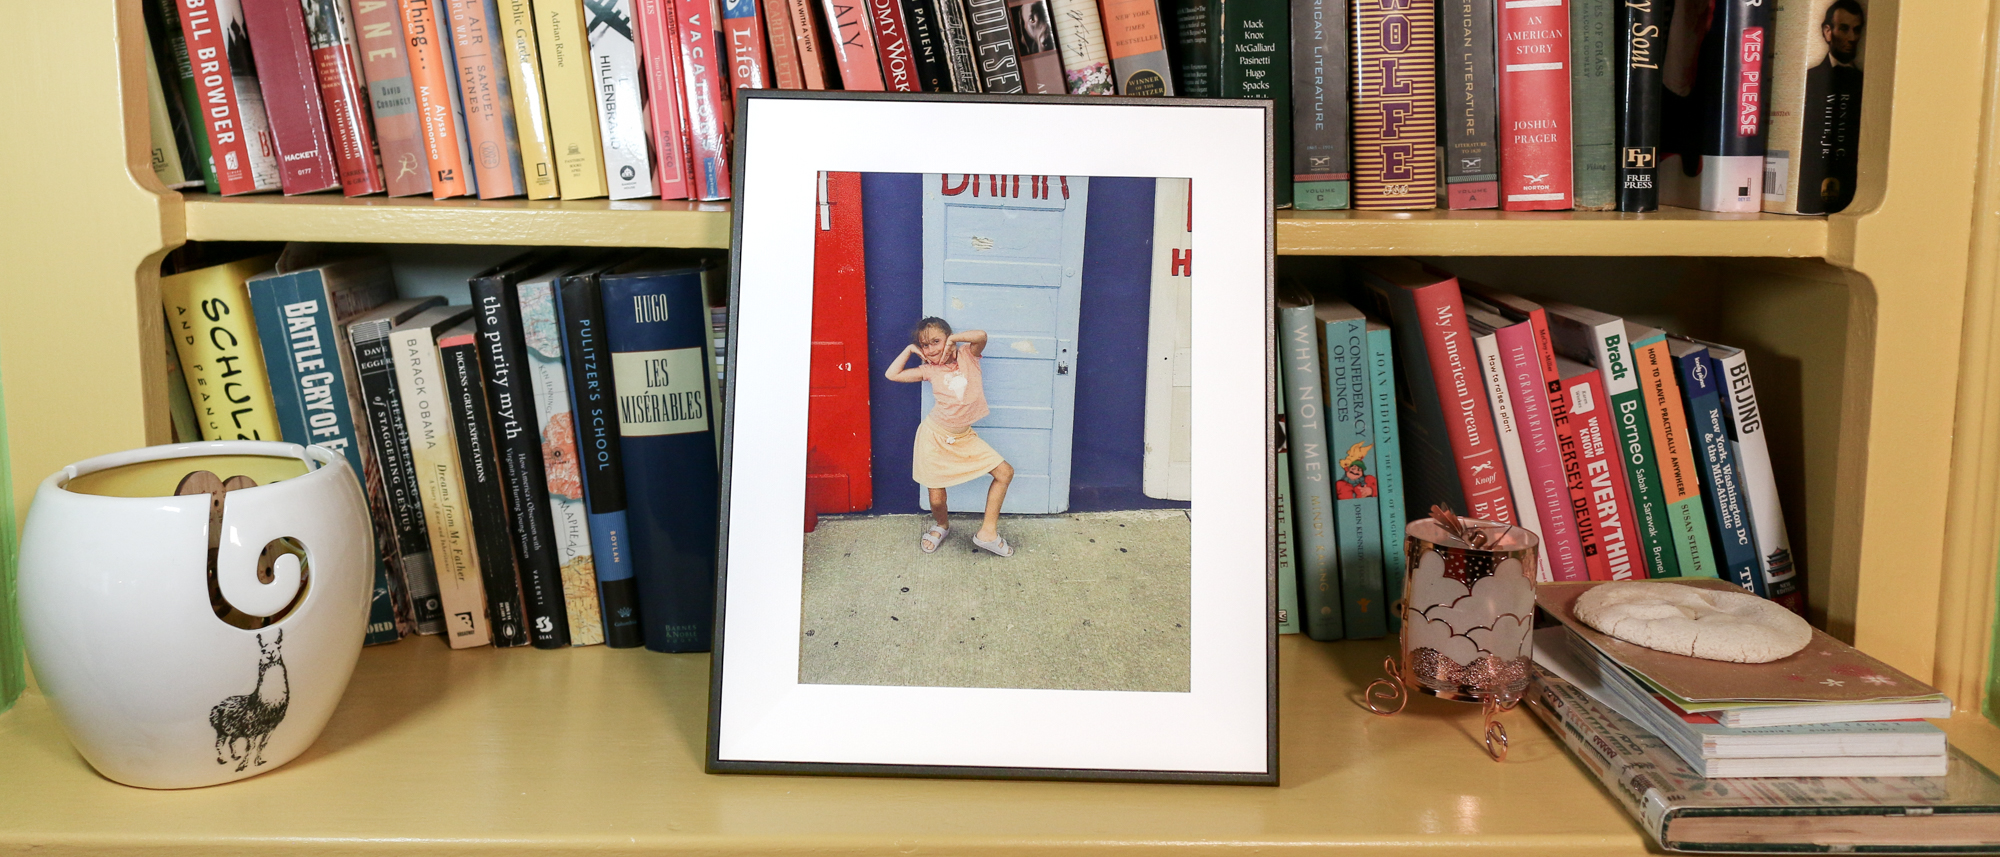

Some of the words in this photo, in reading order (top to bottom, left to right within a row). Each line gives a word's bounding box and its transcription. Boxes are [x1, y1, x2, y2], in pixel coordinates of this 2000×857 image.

[186, 0, 212, 41] BILL
[469, 17, 484, 46] AIR
[551, 11, 561, 41] Adrian
[667, 7, 676, 35] FAUSTUS
[798, 8, 807, 30] WITH
[804, 34, 813, 53] VIEW
[1115, 13, 1130, 22] NEW
[1132, 9, 1151, 18] YORK
[1125, 23, 1145, 32] TIMES
[1243, 19, 1264, 29] Mack
[1527, 16, 1542, 25] AN
[456, 25, 468, 46] WAR
[732, 27, 753, 78] Life
[914, 7, 936, 64] PATIENT
[1115, 34, 1159, 47] BESTSELLER
[1235, 43, 1275, 52] McGalliard
[1244, 30, 1264, 40] Knox
[1505, 29, 1563, 41] AMERICAN
[1516, 44, 1553, 55] STORY
[1631, 23, 1659, 70] Soul
[1743, 30, 1762, 63] YES
[555, 43, 565, 68] Raine
[1239, 55, 1271, 65] Pasinetti
[1245, 68, 1266, 78] Hugo
[1595, 41, 1603, 77] GRASS
[198, 47, 236, 145] BROWDER
[381, 86, 401, 96] DAVID
[464, 67, 480, 114] HYNES
[477, 65, 493, 121] SAMUEL
[1128, 75, 1160, 87] WINNER
[1242, 80, 1270, 91] Spacks
[1314, 46, 1324, 131] LITERATURE
[1378, 0, 1414, 182] OLFE
[1464, 53, 1475, 136] LITERATURE
[376, 97, 411, 110] CORDINGLY
[435, 104, 447, 138] Alyssa
[1740, 71, 1760, 135] PLEASE
[1822, 94, 1835, 139] WHITE,
[334, 99, 351, 160] CATHERWOOD
[419, 85, 439, 160] Mastromonaco
[1513, 120, 1557, 131] JOSHUA
[1514, 134, 1557, 144] PRAGER
[284, 150, 319, 162] HACKETT
[663, 130, 674, 168] PORTICO
[1821, 141, 1832, 159] JR.
[1624, 181, 1652, 189] PRESS
[176, 306, 195, 346] AND
[483, 296, 501, 326] the
[633, 293, 669, 324] HUGO
[1436, 305, 1453, 326] My
[284, 299, 325, 373] BATTLE
[1348, 323, 1359, 332] A
[364, 346, 388, 356] DAVE
[484, 331, 510, 388] purity
[1293, 325, 1312, 373] WHY
[1333, 344, 1345, 365] OF
[1443, 330, 1469, 397] American
[1488, 354, 1496, 373] How
[1512, 345, 1525, 368] THE
[1604, 334, 1628, 381] Bradt
[1647, 347, 1658, 367] HOW
[201, 297, 261, 441] SCHULZ
[455, 351, 468, 387] DICKENS
[538, 364, 549, 380] KEN
[644, 358, 669, 388] LES
[1348, 337, 1366, 437] CONFEDERACY
[1376, 352, 1385, 386] JOAN
[1492, 374, 1499, 383] to
[1652, 367, 1660, 378] TO
[301, 371, 335, 411] CRY
[372, 396, 387, 407] of
[388, 387, 396, 395] A
[407, 338, 427, 396] BARACK
[418, 400, 437, 450] OBAMA
[462, 393, 475, 418] GREAT
[579, 319, 601, 402] PULITZER'S
[591, 409, 610, 471] SCHOOL
[620, 390, 703, 424] MISÉRABLES
[1299, 386, 1317, 430] NOT
[1335, 366, 1349, 422] DUNCES
[1495, 382, 1503, 403] raise
[1654, 378, 1666, 406] TRAVEL
[1729, 362, 1760, 435] BEIJING
[309, 411, 340, 437] OF
[498, 392, 522, 441] myth
[1379, 393, 1392, 443] DIDION
[1461, 399, 1481, 447] Dream
[1500, 411, 1511, 433] plant
[1518, 373, 1547, 453] GRAMMARIANS
[1551, 395, 1569, 427] THE
[378, 411, 401, 484] STAGGERING
[391, 399, 418, 497] HEARTBREAKING
[1579, 428, 1595, 459] KNOW
[1588, 416, 1605, 456] WOMEN
[1661, 407, 1678, 457] PRACTICALLY
[1704, 433, 1713, 443] &
[467, 418, 486, 483] EXPECTATIONS
[1303, 443, 1322, 482] ME?
[1557, 434, 1584, 490] JERSEY
[1708, 444, 1717, 464] the
[437, 464, 449, 502] Dreams
[1475, 472, 1497, 485] Knopf
[1620, 400, 1645, 465] Borneo
[1636, 468, 1648, 494] Sabah
[1643, 502, 1657, 538] Sarawak
[1653, 545, 1667, 574] Brunei
[1670, 457, 1686, 497] ANYWHERE
[1709, 408, 1720, 433] New
[1715, 434, 1727, 463] York,
[1722, 463, 1742, 529] Washington
[1735, 528, 1748, 546] DC
[395, 489, 412, 532] GENIUS
[506, 448, 517, 481] Virginity
[512, 485, 521, 512] Hurting
[517, 513, 525, 534] Young
[521, 534, 530, 559] Women
[521, 470, 532, 502] America's
[527, 502, 537, 536] Obsession
[532, 536, 542, 550] with
[1385, 476, 1393, 494] YEAR
[1389, 513, 1398, 549] MAGICAL
[1543, 479, 1565, 536] CATHLEEN
[1711, 463, 1731, 529] Mid-Atlantic
[442, 503, 455, 527] from
[558, 500, 580, 557] MAPHEAD
[1311, 495, 1325, 538] MINDY
[1353, 503, 1362, 528] JOHN
[1574, 497, 1594, 542] DEVIL
[1587, 459, 1632, 581] EVERYTHIN
[449, 530, 460, 545] My
[609, 530, 620, 563] BOYLAN
[1278, 530, 1289, 569] TIME
[1355, 528, 1364, 562] KENNEDY
[1680, 504, 1695, 535] SUSAN
[1688, 535, 1703, 572] STELLIN
[453, 548, 466, 582] Father
[1316, 545, 1330, 592] KALING
[1557, 539, 1577, 580] SCHINE
[533, 570, 543, 606] VALENTI
